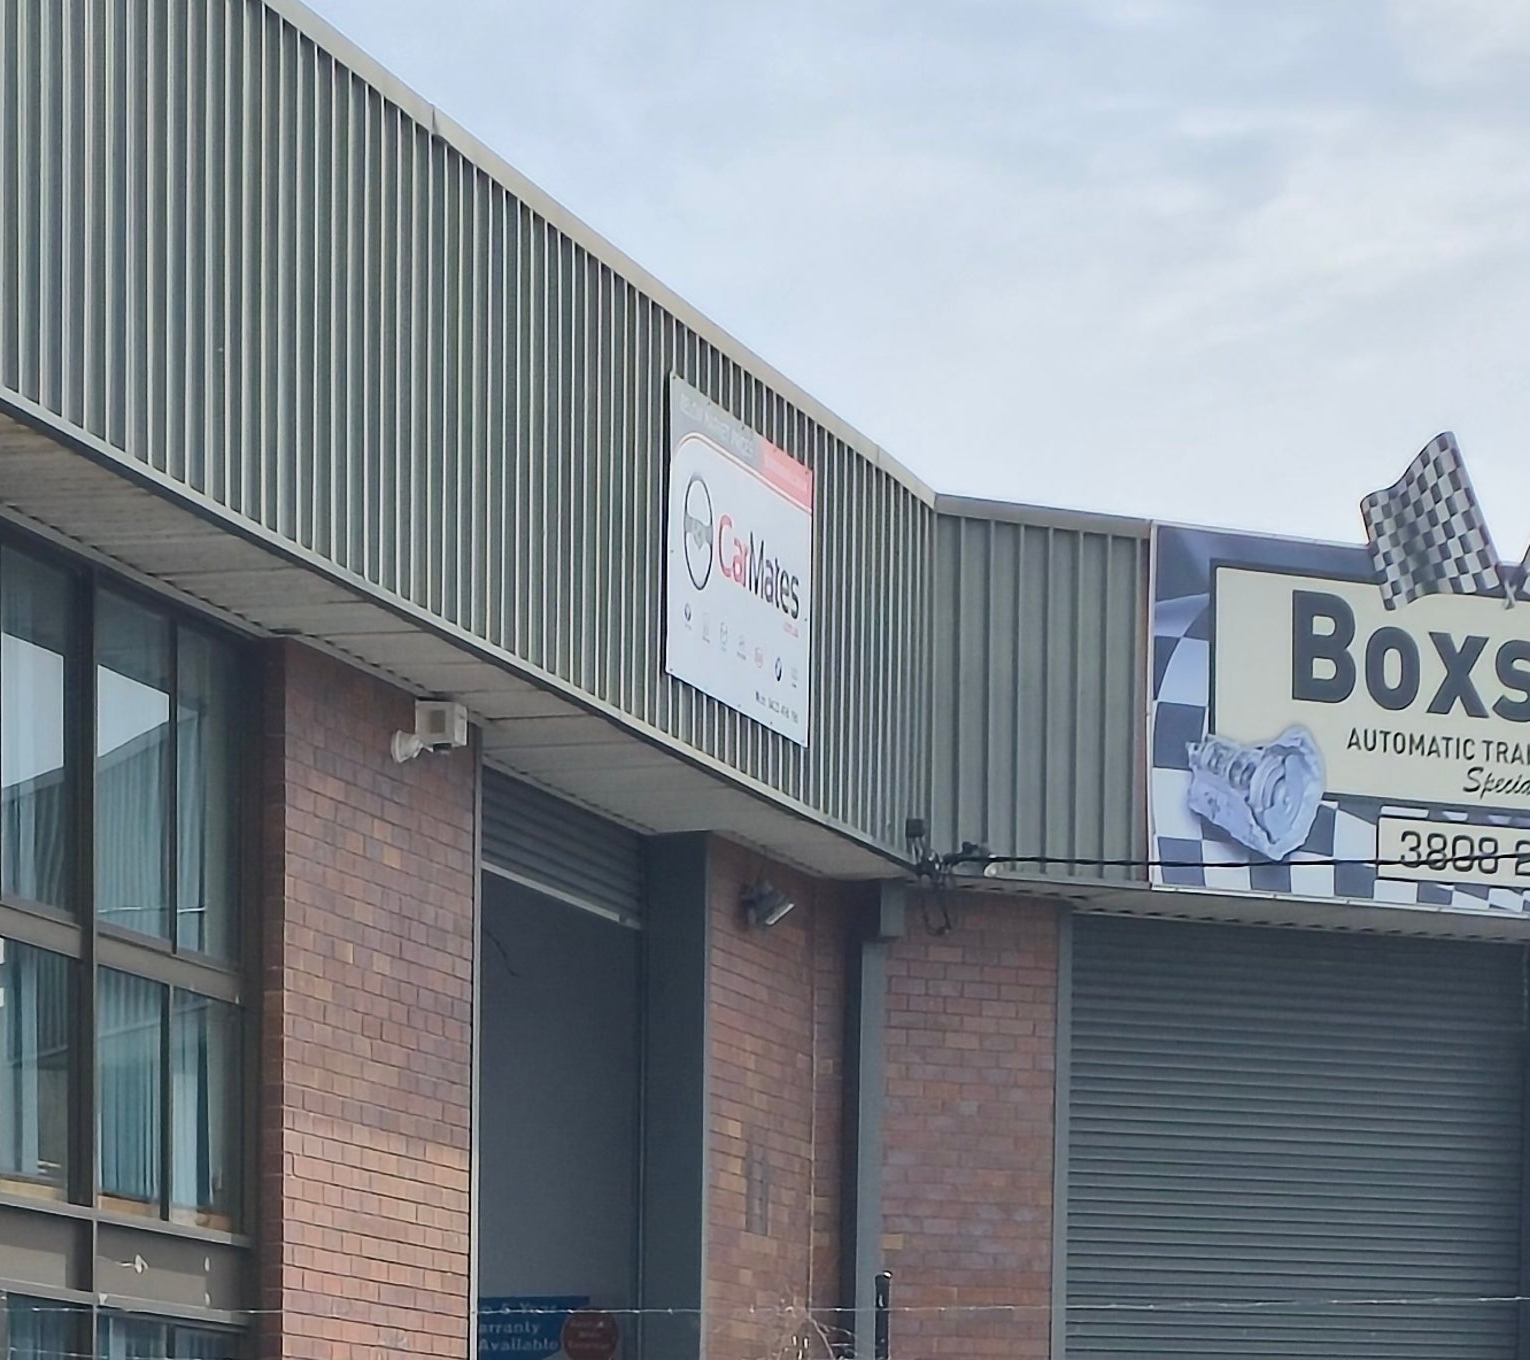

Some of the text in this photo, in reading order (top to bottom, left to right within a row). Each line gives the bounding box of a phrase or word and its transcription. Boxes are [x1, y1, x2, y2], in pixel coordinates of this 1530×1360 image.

[718, 513, 801, 620] CarMates
[1346, 727, 1530, 768] AUTOMATIC TRA
[1400, 829, 1499, 875] 3808
[479, 1336, 559, 1351] Available
[480, 1320, 540, 1335] arranty
